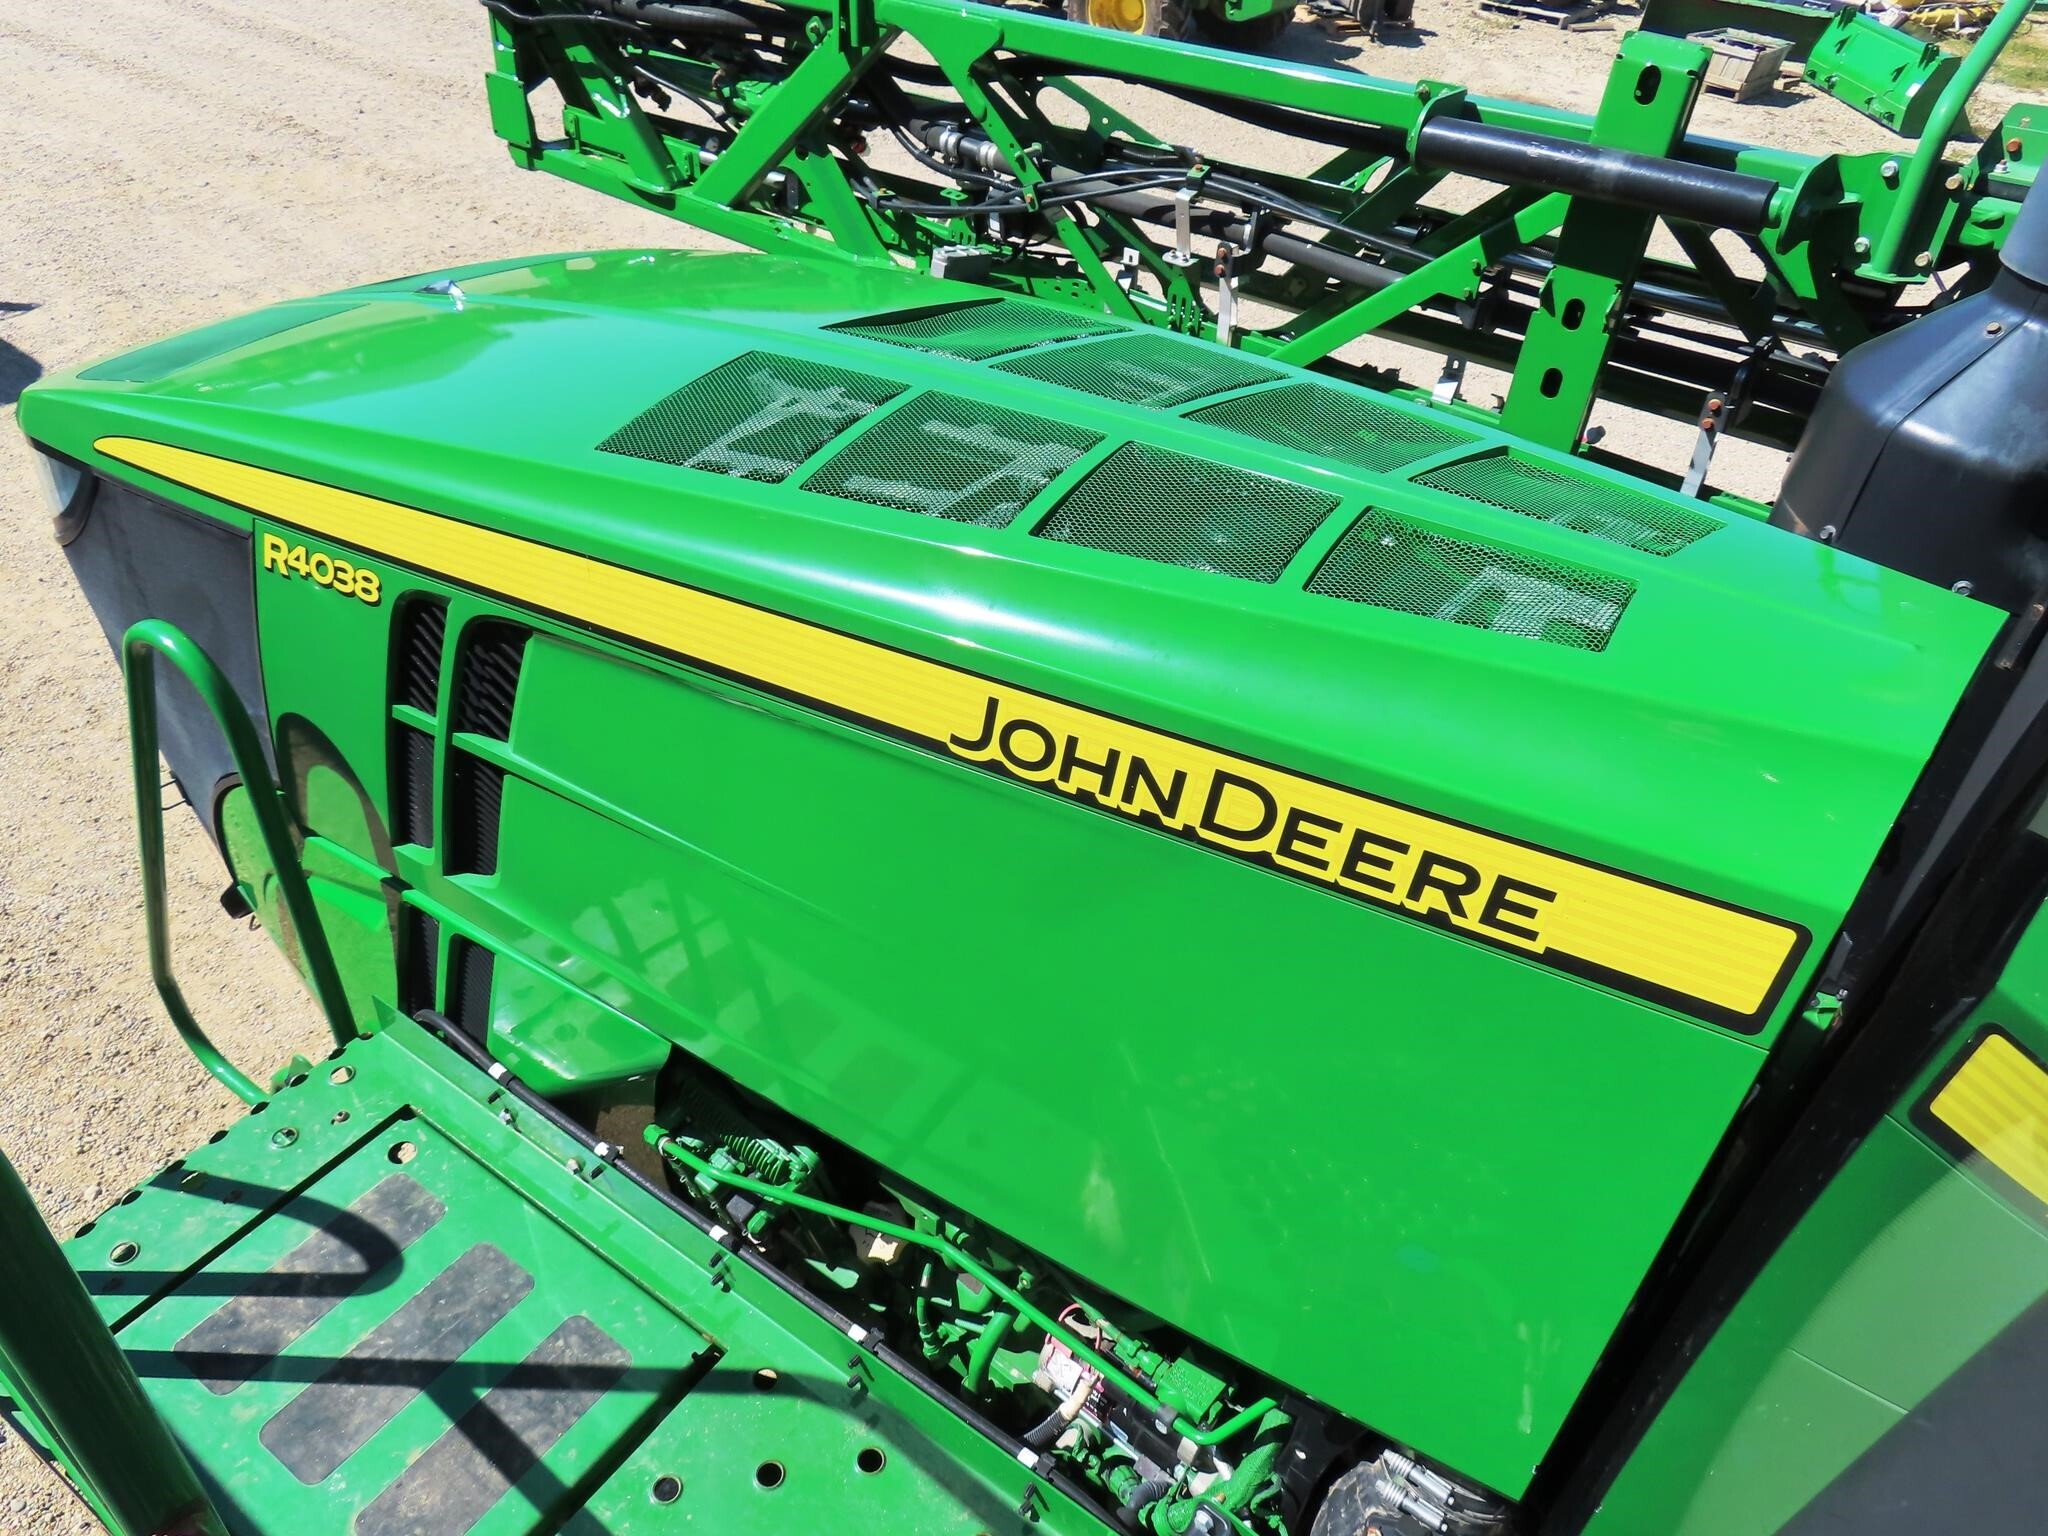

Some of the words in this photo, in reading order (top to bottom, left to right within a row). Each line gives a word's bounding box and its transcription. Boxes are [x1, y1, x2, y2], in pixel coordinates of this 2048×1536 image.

[263, 532, 381, 605] R4038
[949, 696, 1187, 820] JOHN
[1199, 768, 1557, 942] DEERE
